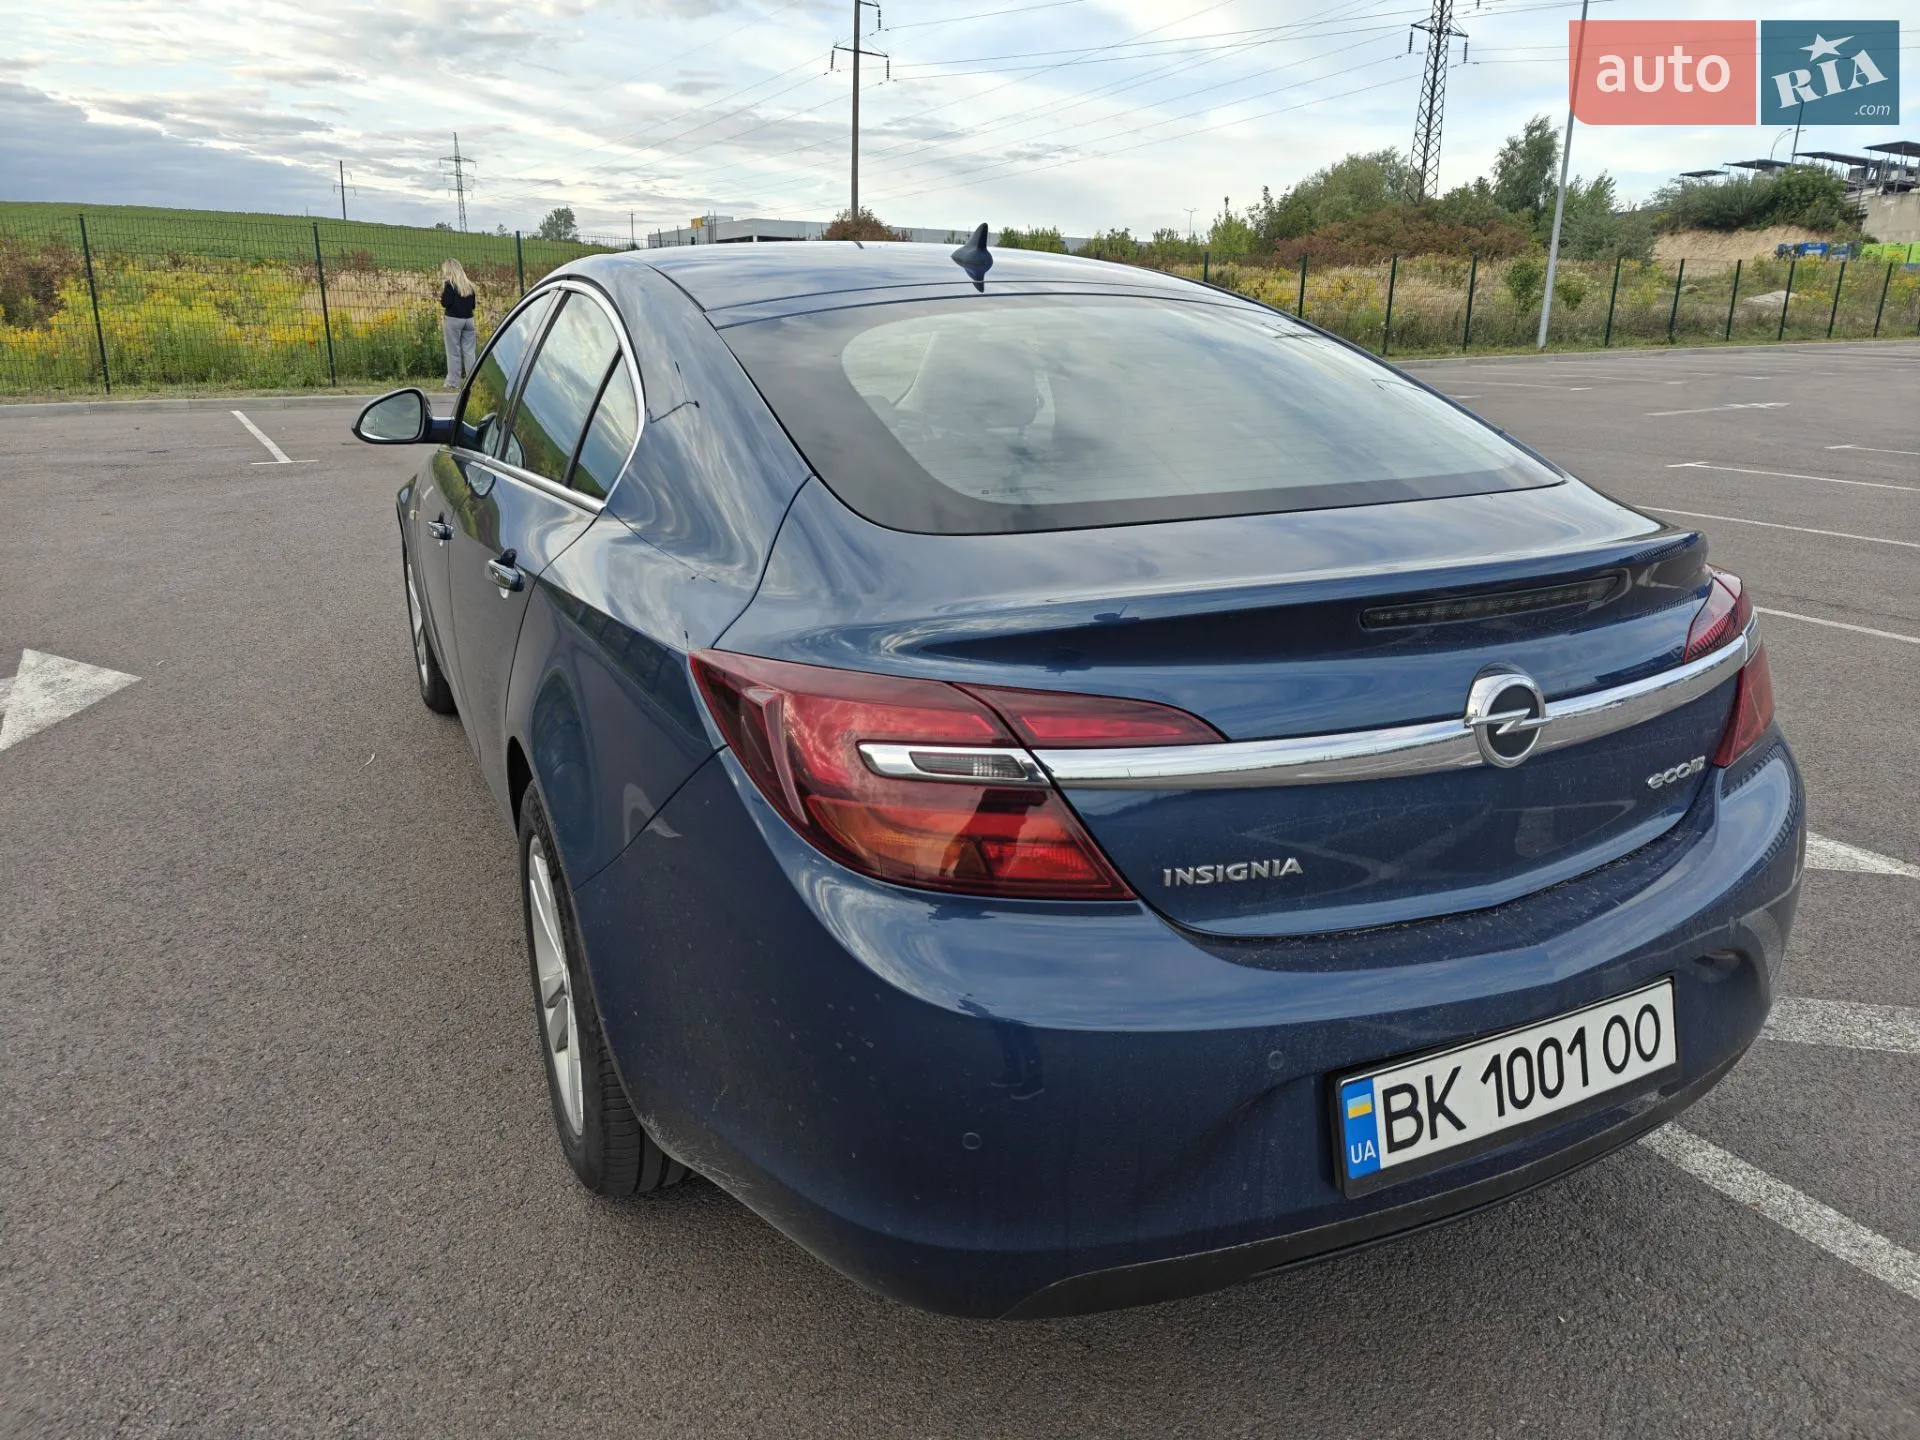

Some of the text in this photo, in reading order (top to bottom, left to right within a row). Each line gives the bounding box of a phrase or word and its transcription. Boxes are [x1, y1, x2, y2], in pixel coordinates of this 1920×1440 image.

[1163, 857, 1303, 887] INSIGNIA
[1382, 1066, 1467, 1154] BK
[1480, 1026, 1589, 1118] 1001
[1351, 1139, 1376, 1164] UA
